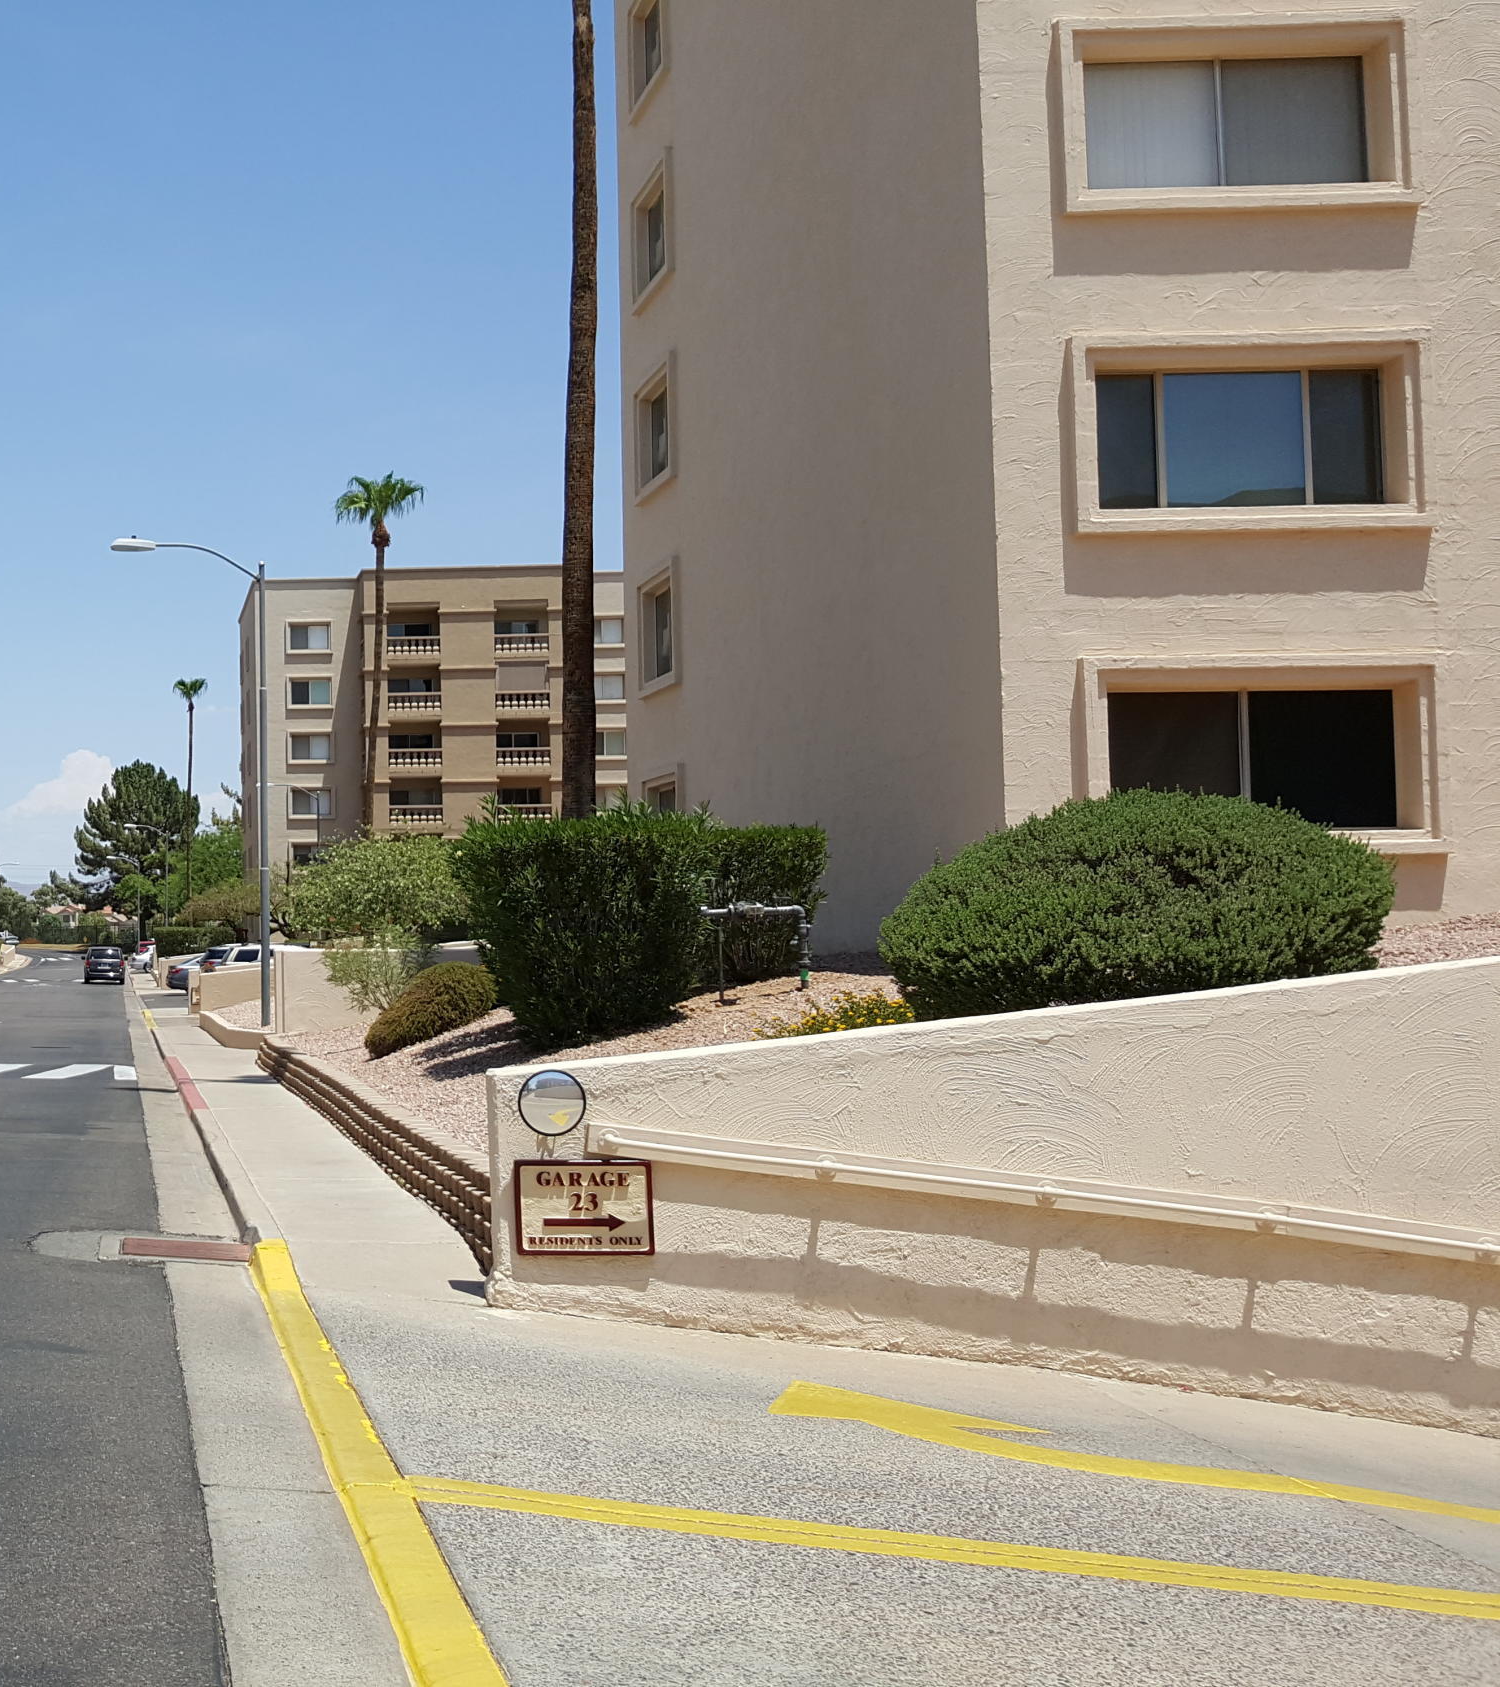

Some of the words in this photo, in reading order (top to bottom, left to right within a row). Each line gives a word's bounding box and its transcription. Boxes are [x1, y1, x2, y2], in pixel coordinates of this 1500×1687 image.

[535, 1170, 630, 1188] GARAGE
[569, 1191, 599, 1212] 23
[527, 1235, 603, 1247] RESIDENTS
[609, 1235, 644, 1247] ONLY
